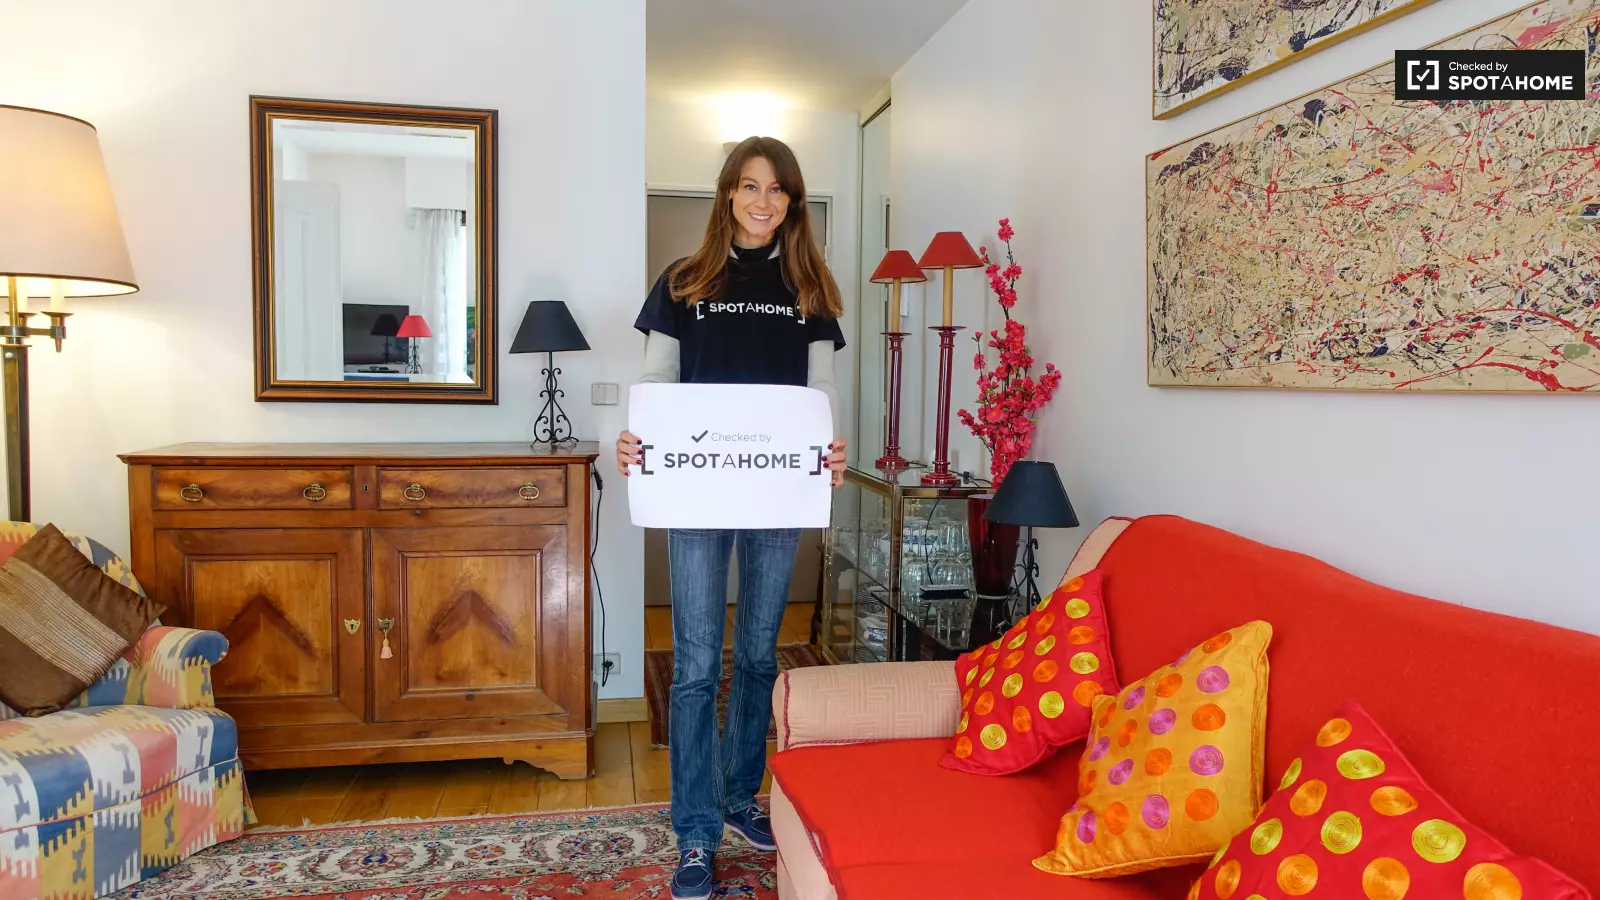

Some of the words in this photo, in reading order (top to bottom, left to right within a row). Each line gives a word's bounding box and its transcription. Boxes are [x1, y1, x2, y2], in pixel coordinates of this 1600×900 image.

[709, 302, 794, 317] SPOTAHOME
[710, 432, 756, 442] Checked
[759, 432, 772, 444] by
[664, 452, 801, 469] SPOTAHOME
